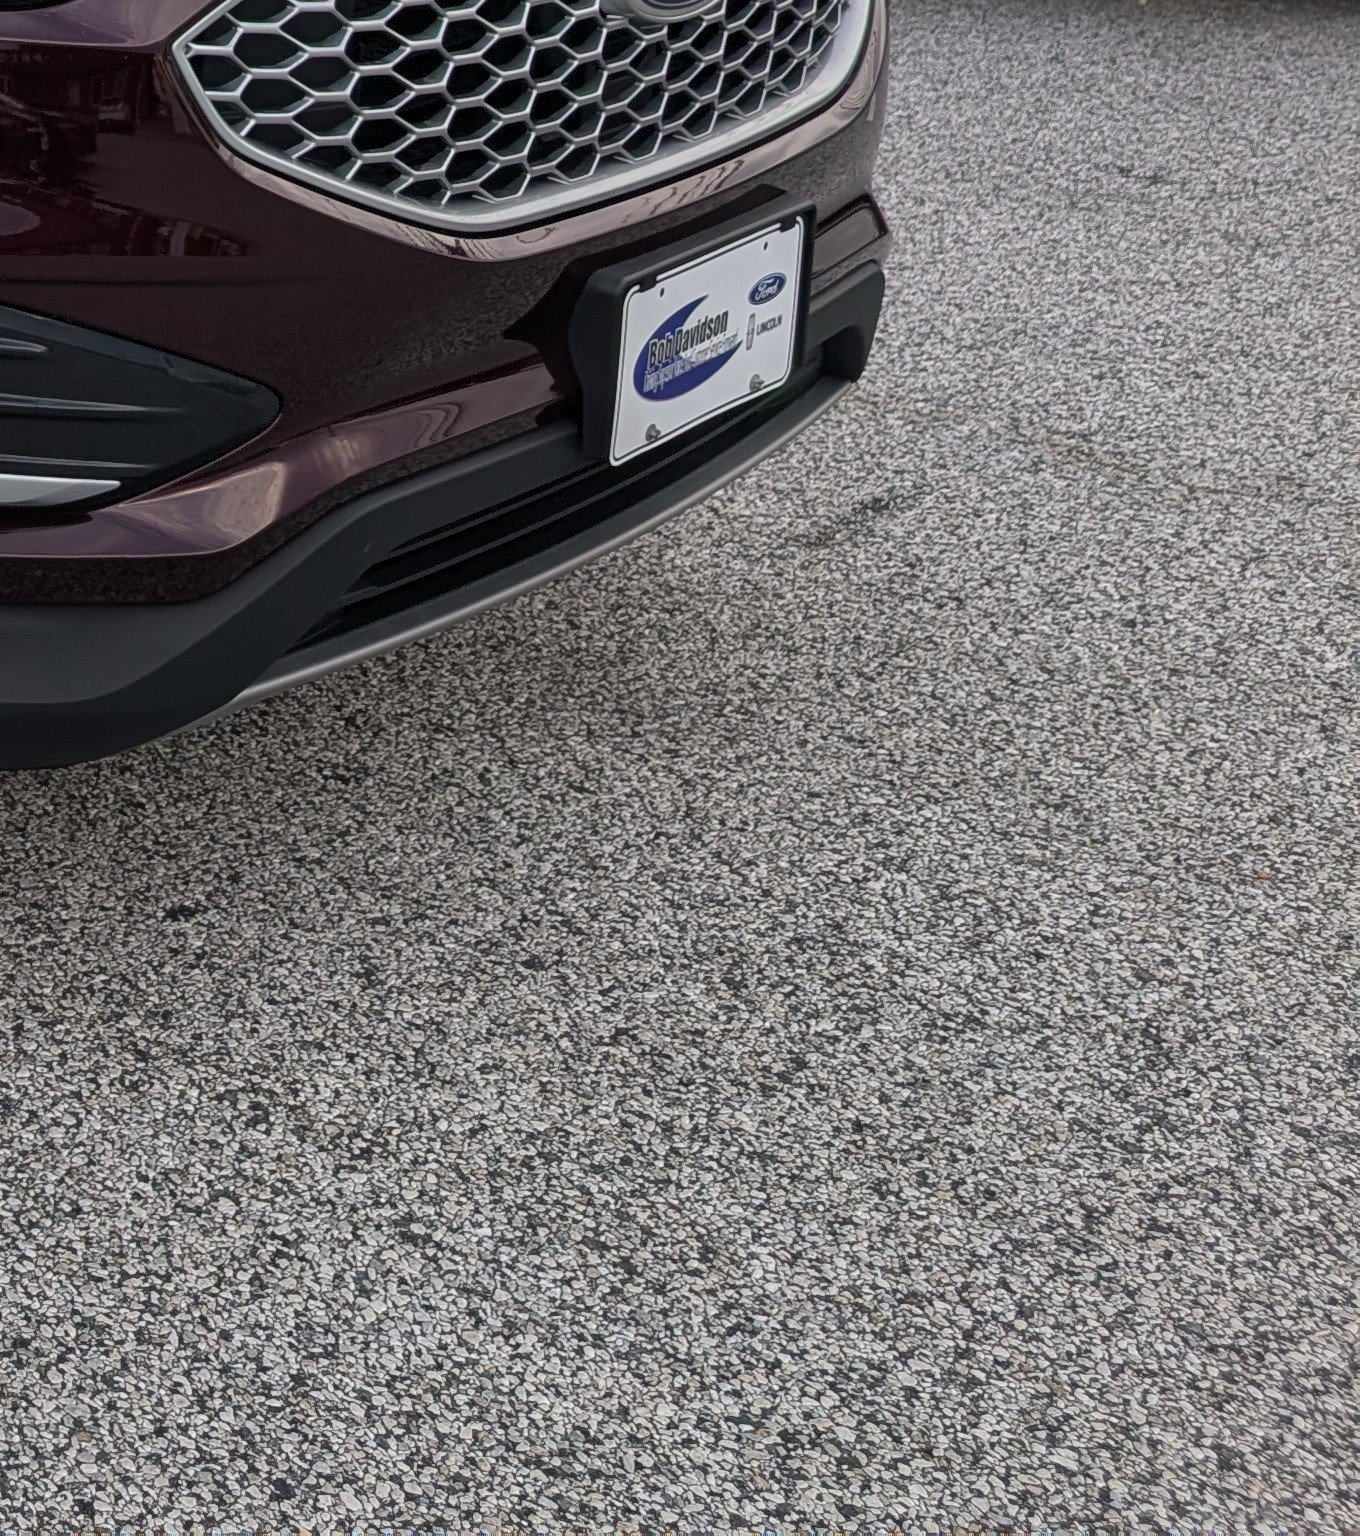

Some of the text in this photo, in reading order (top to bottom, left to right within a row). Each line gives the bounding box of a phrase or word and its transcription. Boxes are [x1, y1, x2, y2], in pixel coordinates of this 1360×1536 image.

[754, 276, 780, 302] Ford
[648, 333, 673, 369] Bob
[674, 309, 729, 356] Davidson
